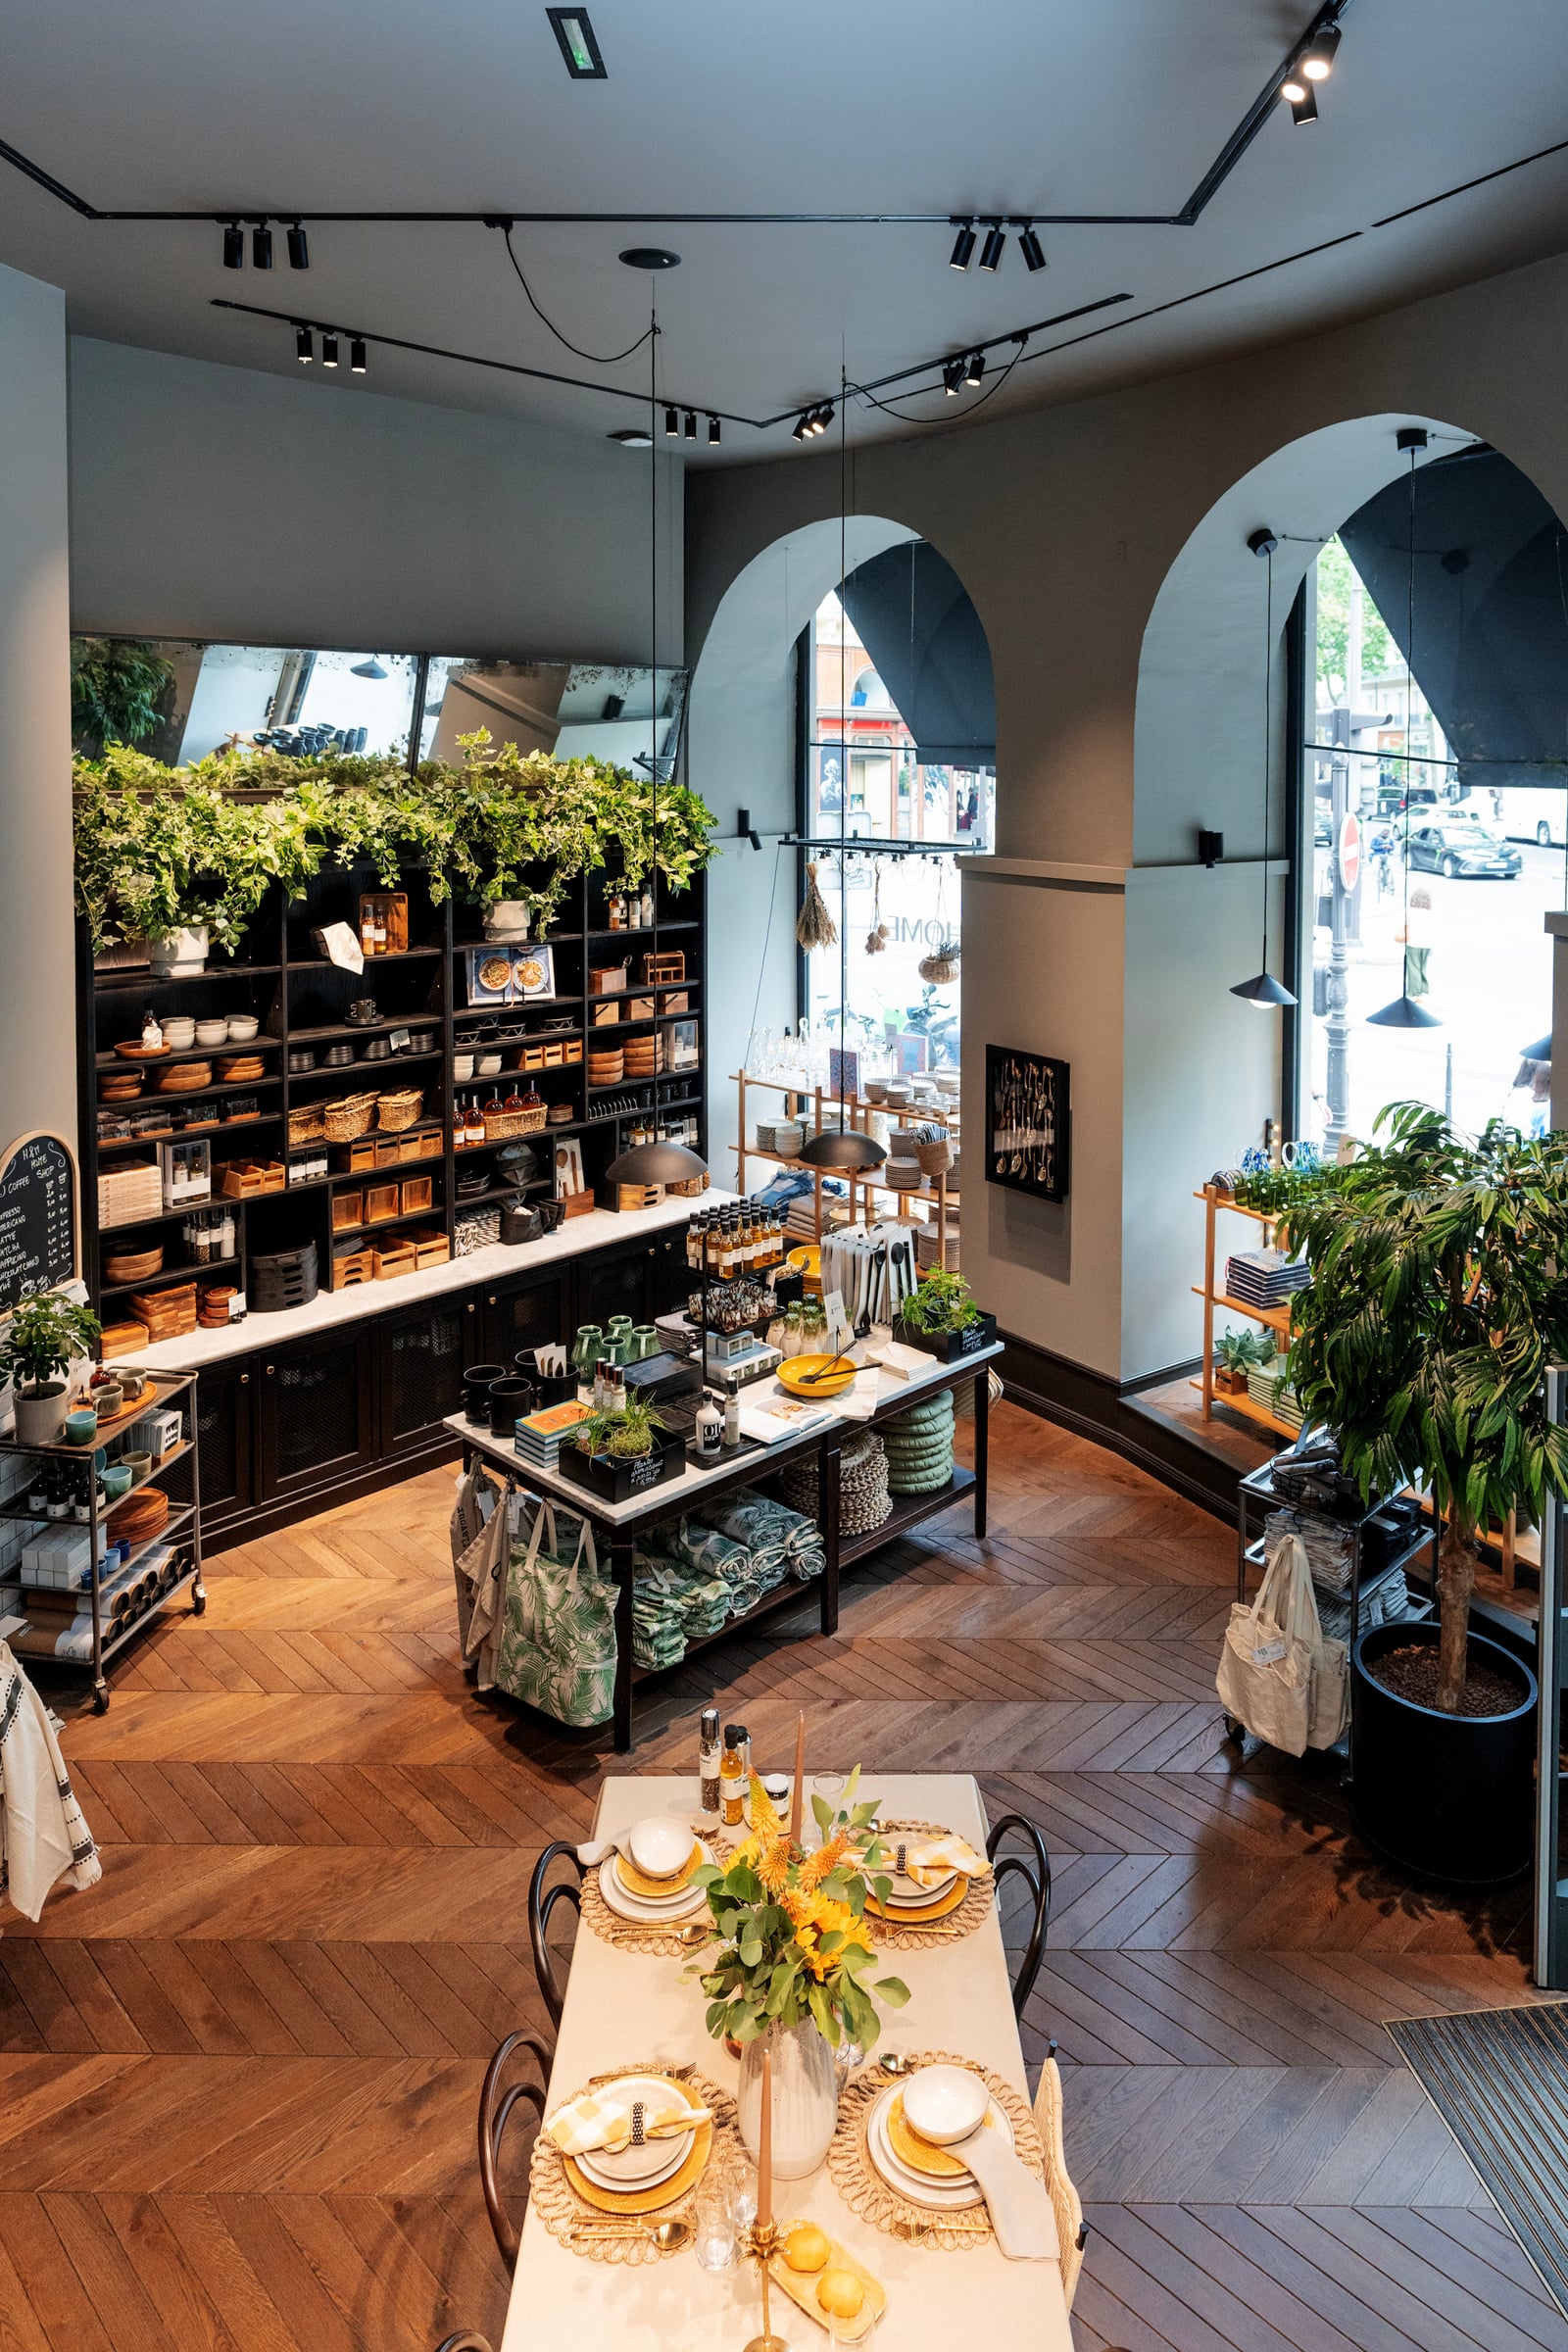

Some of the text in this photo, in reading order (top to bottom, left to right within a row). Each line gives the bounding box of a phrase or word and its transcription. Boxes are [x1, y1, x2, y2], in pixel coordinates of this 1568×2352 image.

[23, 1145, 39, 1160] H&M
[31, 1153, 47, 1169] HOME
[8, 1166, 55, 1194] COFFEE SHOP
[457, 1506, 470, 1548] flavour
